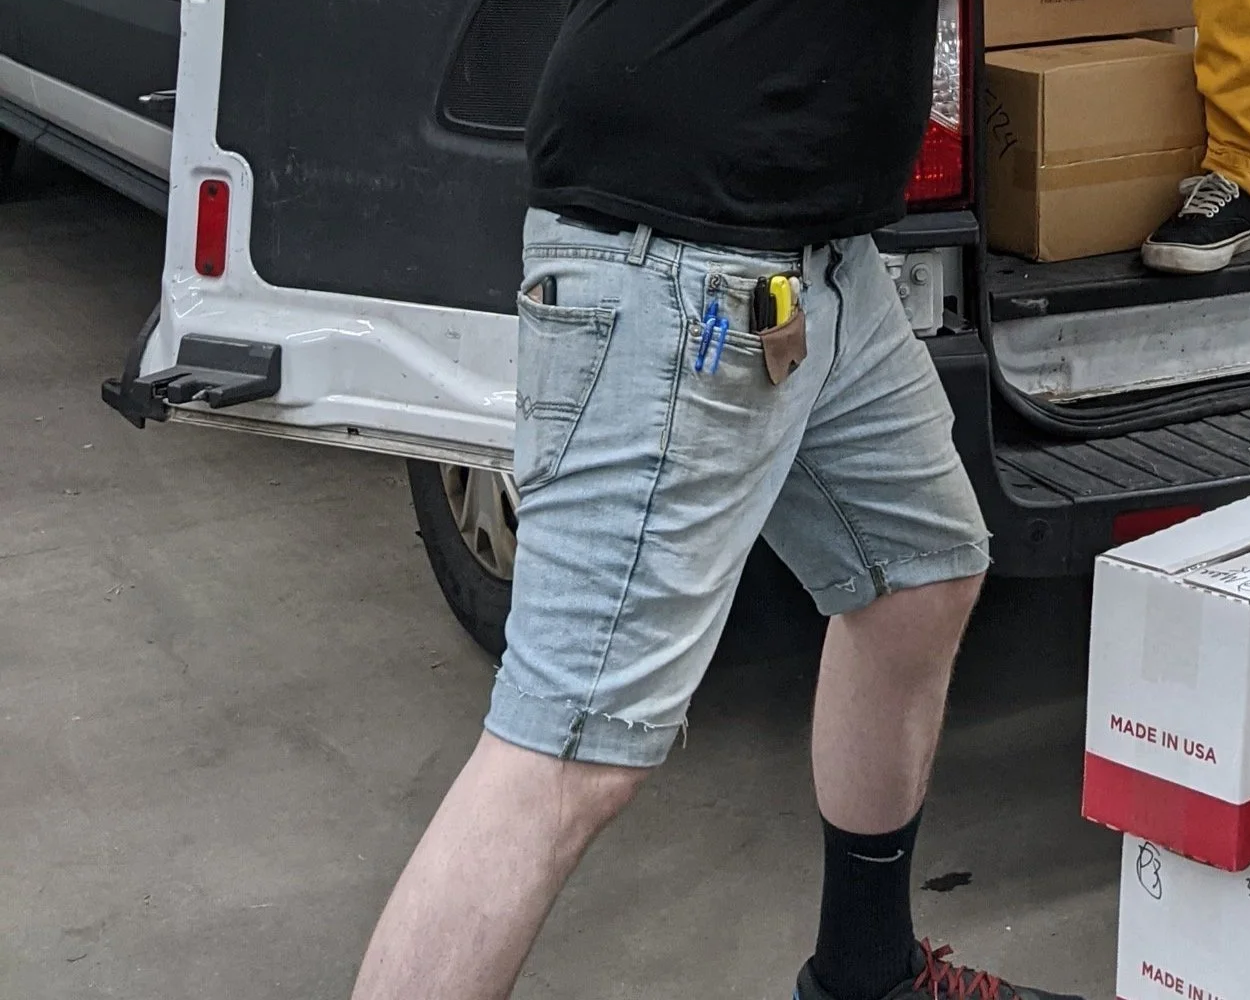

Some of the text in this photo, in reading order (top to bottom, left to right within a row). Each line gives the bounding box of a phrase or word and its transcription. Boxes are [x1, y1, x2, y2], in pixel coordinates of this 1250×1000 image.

[1111, 714, 1217, 764] MADE IN USA
[1142, 960, 1203, 1000] MADE IN
